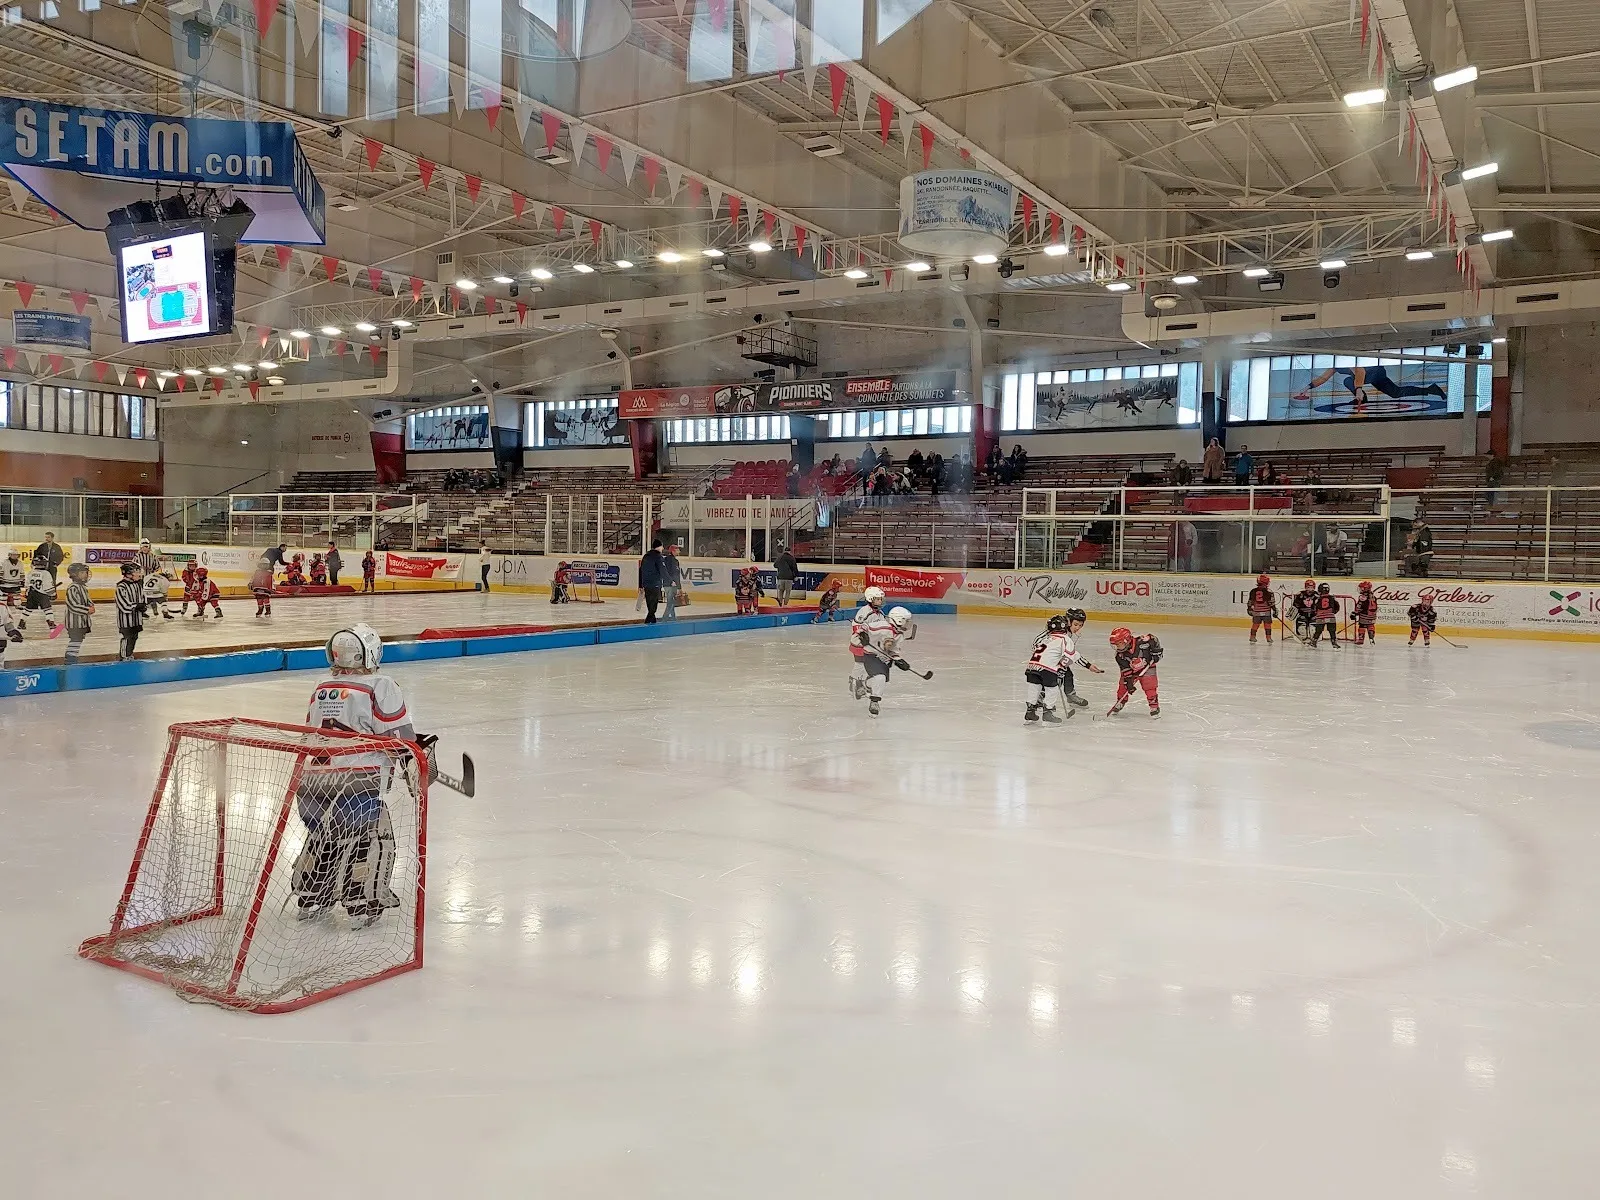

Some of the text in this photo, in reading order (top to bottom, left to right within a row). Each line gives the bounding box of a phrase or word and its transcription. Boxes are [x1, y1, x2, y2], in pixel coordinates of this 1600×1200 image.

[917, 176, 1009, 196] NOS DOMAINES SKIABLES
[768, 383, 833, 405] PIONNIERS
[846, 379, 891, 393] ENSEMBLE
[858, 389, 945, 403] CONQUÊTE DES SOMMETS
[706, 507, 734, 518] VIBREZ
[737, 508, 762, 518] TOTE
[1028, 575, 1088, 603] Rebelles
[1372, 585, 1495, 604] Casa Valerio
[1445, 608, 1486, 617] Pizzeria
